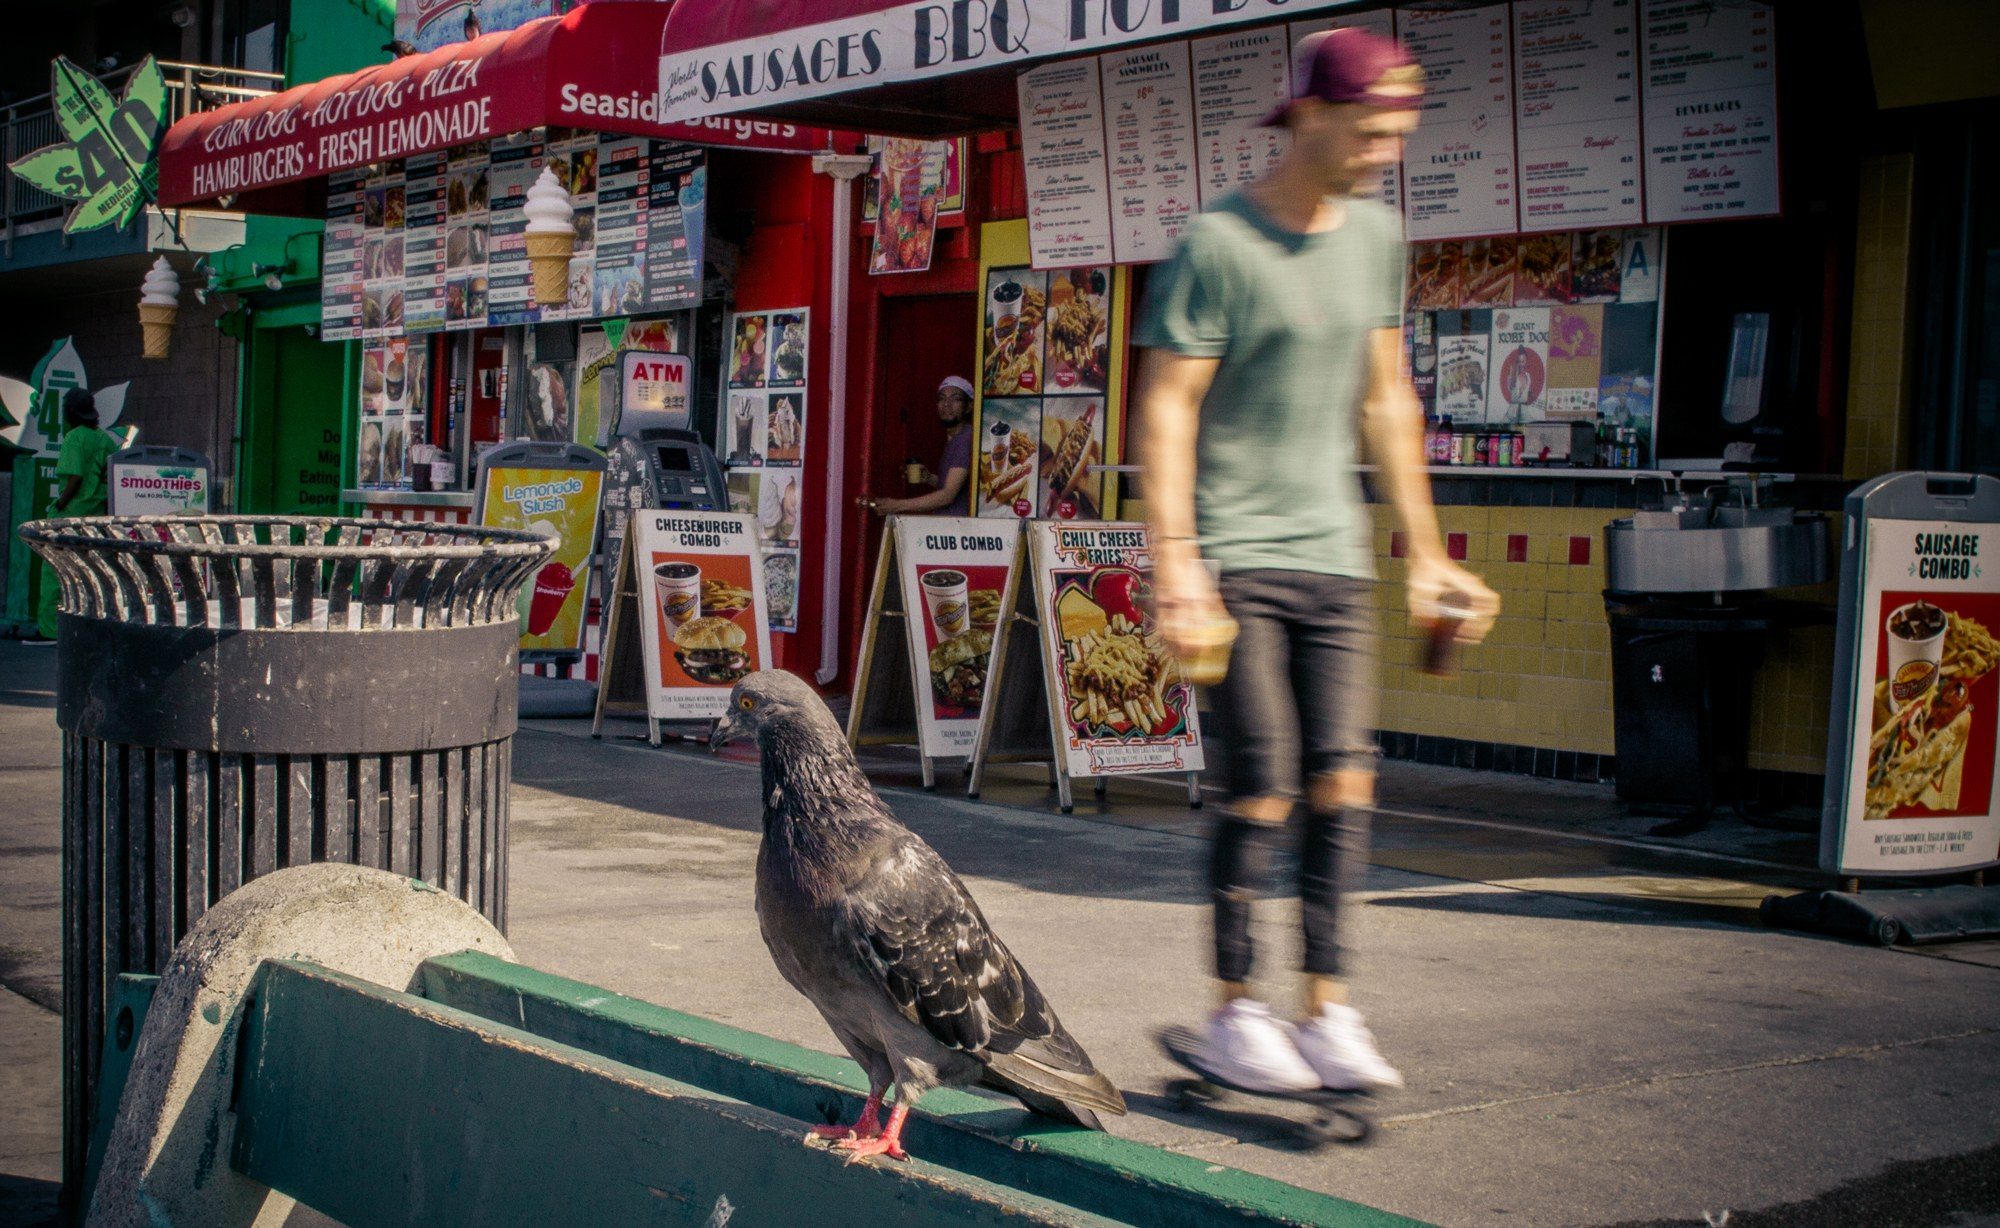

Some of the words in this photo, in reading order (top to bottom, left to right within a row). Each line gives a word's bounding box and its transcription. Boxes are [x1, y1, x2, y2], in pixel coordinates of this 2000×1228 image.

[914, 0, 1030, 69] BBQ
[669, 60, 698, 89] World
[701, 29, 882, 104] SAUSAGES
[205, 117, 252, 153] CORN
[255, 103, 301, 142] DOG
[311, 89, 352, 128] HOT
[357, 75, 410, 118] DOG
[419, 57, 483, 100] PIZZA
[561, 83, 660, 122] Seasid
[663, 85, 699, 114] Famous
[1676, 100, 1741, 117] BEVERAGES
[193, 142, 304, 196] HAMBURGERS
[318, 127, 372, 170] FRESH
[378, 96, 491, 158] LEMONADE
[1626, 241, 1648, 277] A
[632, 362, 683, 384] ATM
[503, 478, 583, 503] Lemonade
[523, 496, 565, 515] Slush
[655, 517, 743, 535] CHEESEBURGER
[679, 533, 721, 548] COMBO
[925, 534, 957, 551] CLUB
[961, 535, 1003, 552] COMBO
[1062, 530, 1096, 548] CHILI
[1099, 530, 1145, 548] CHEESE
[1915, 533, 1979, 557] SAUSAGE
[1087, 548, 1124, 565] FRIES
[1919, 557, 1970, 579] COMBO
[536, 586, 566, 599] Strawberry
